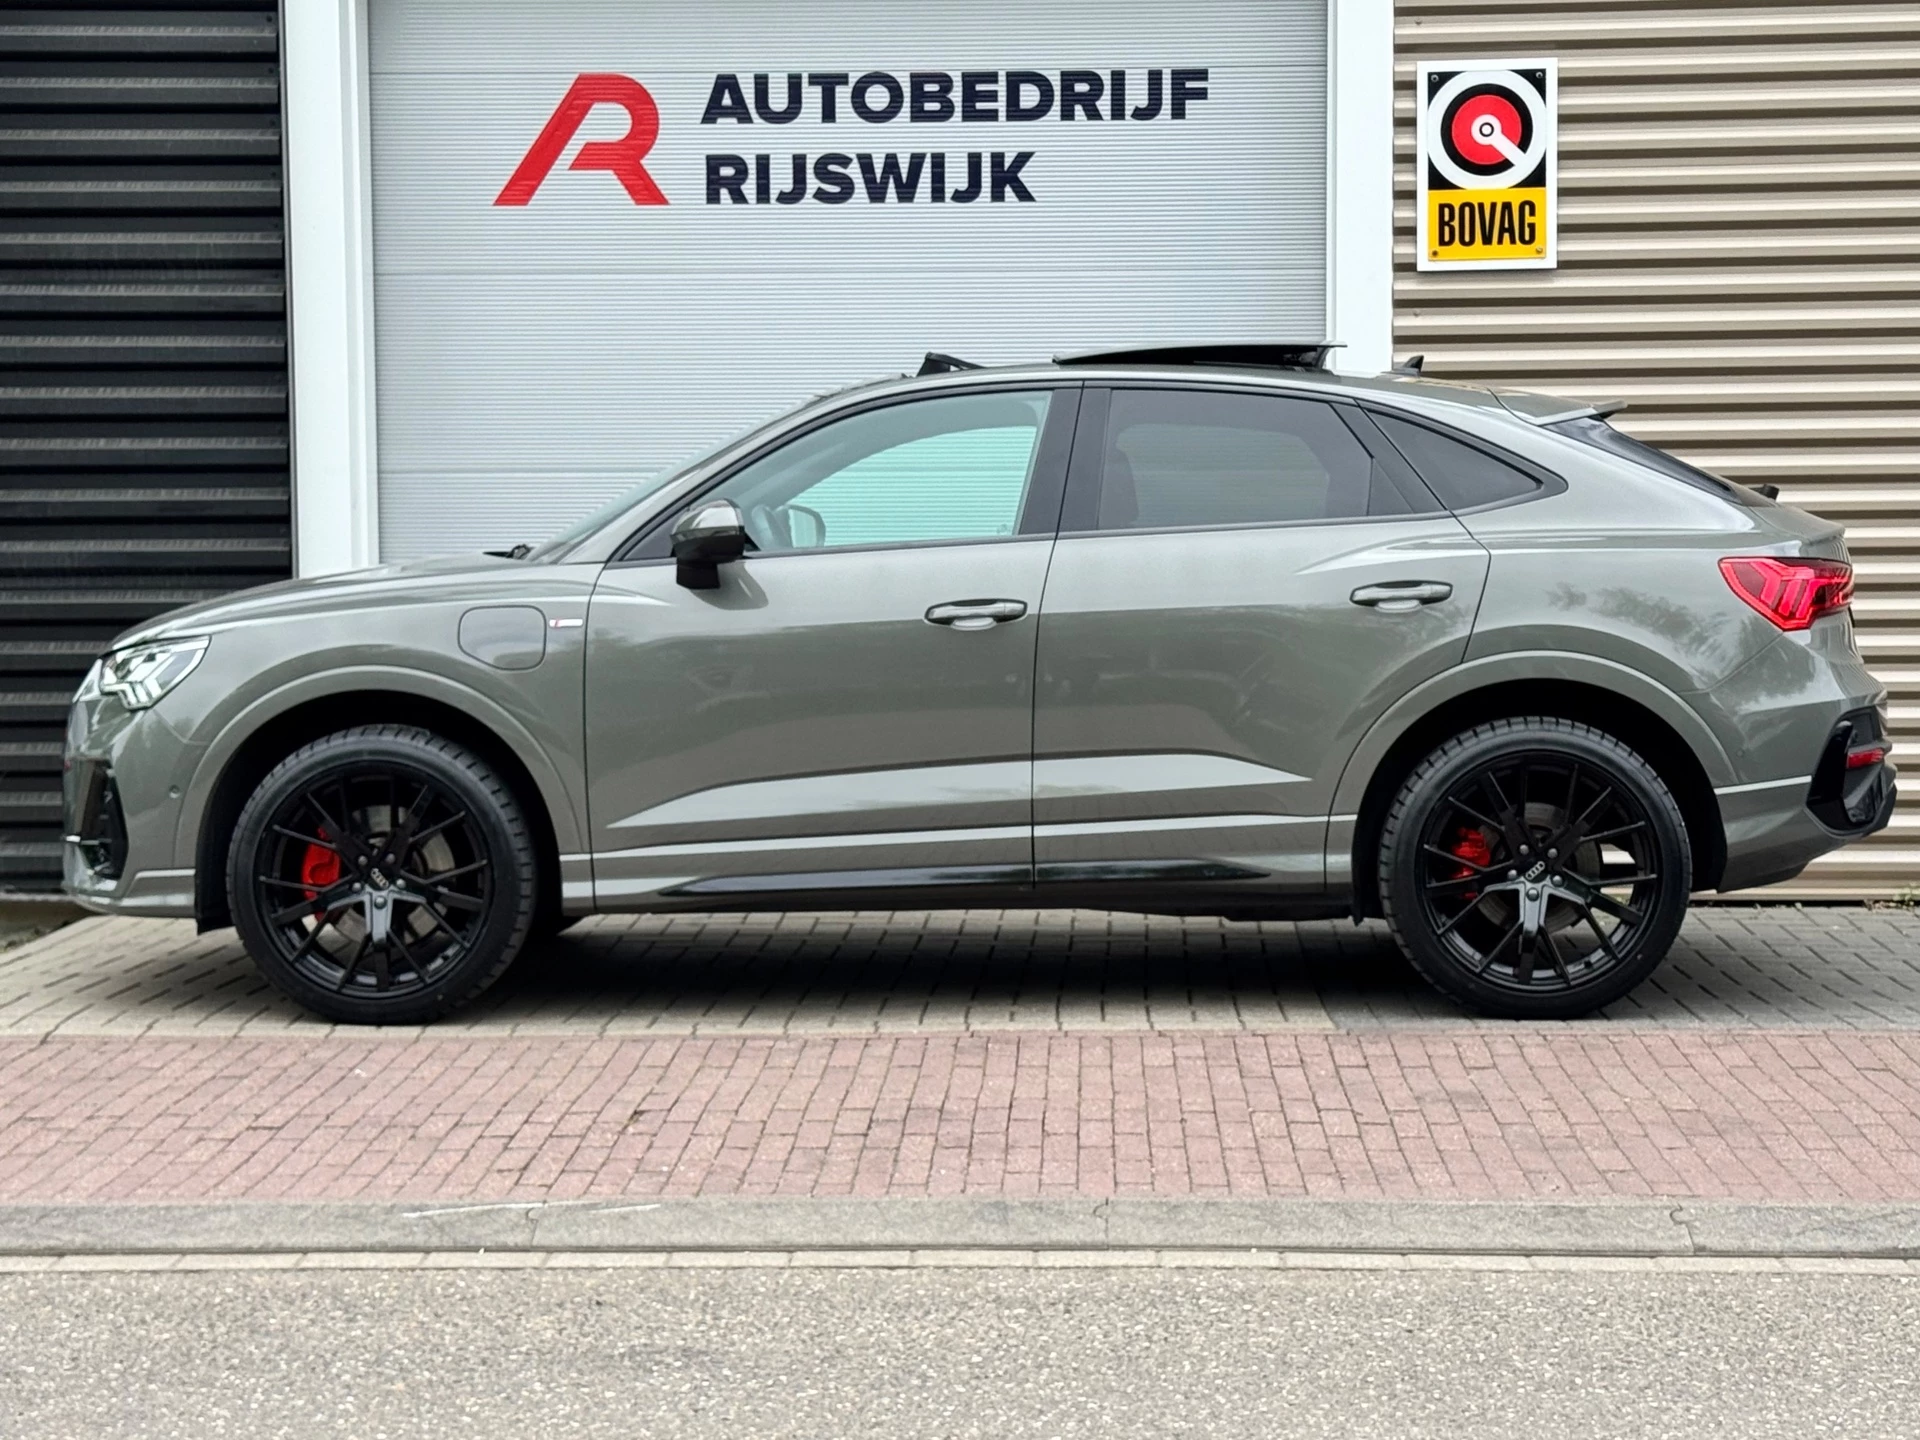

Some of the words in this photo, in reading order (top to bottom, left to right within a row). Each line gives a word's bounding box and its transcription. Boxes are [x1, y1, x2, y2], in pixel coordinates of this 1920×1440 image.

[701, 69, 1209, 124] AUTOBEDRIJF
[706, 152, 1036, 205] RIJSWIJK
[1438, 200, 1536, 247] BOVAG
